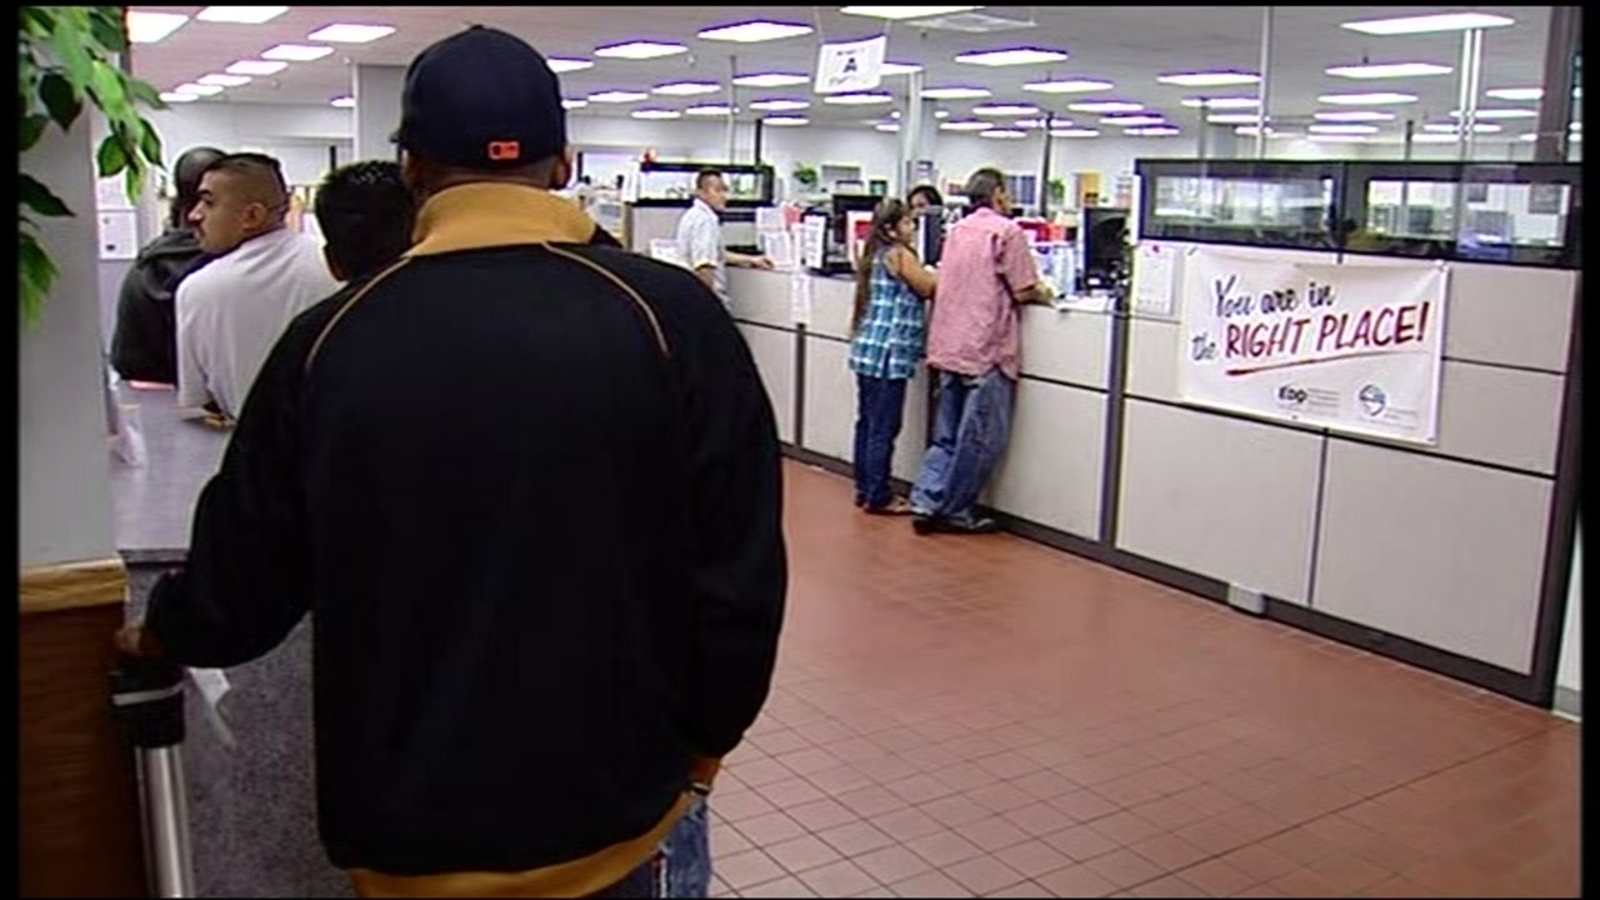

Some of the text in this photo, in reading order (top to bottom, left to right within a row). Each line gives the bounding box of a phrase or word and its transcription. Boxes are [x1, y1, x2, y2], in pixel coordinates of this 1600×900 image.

[843, 57, 857, 73] A
[1215, 275, 1336, 318] You are in
[1191, 301, 1430, 361] the RIGHT PLACE!
